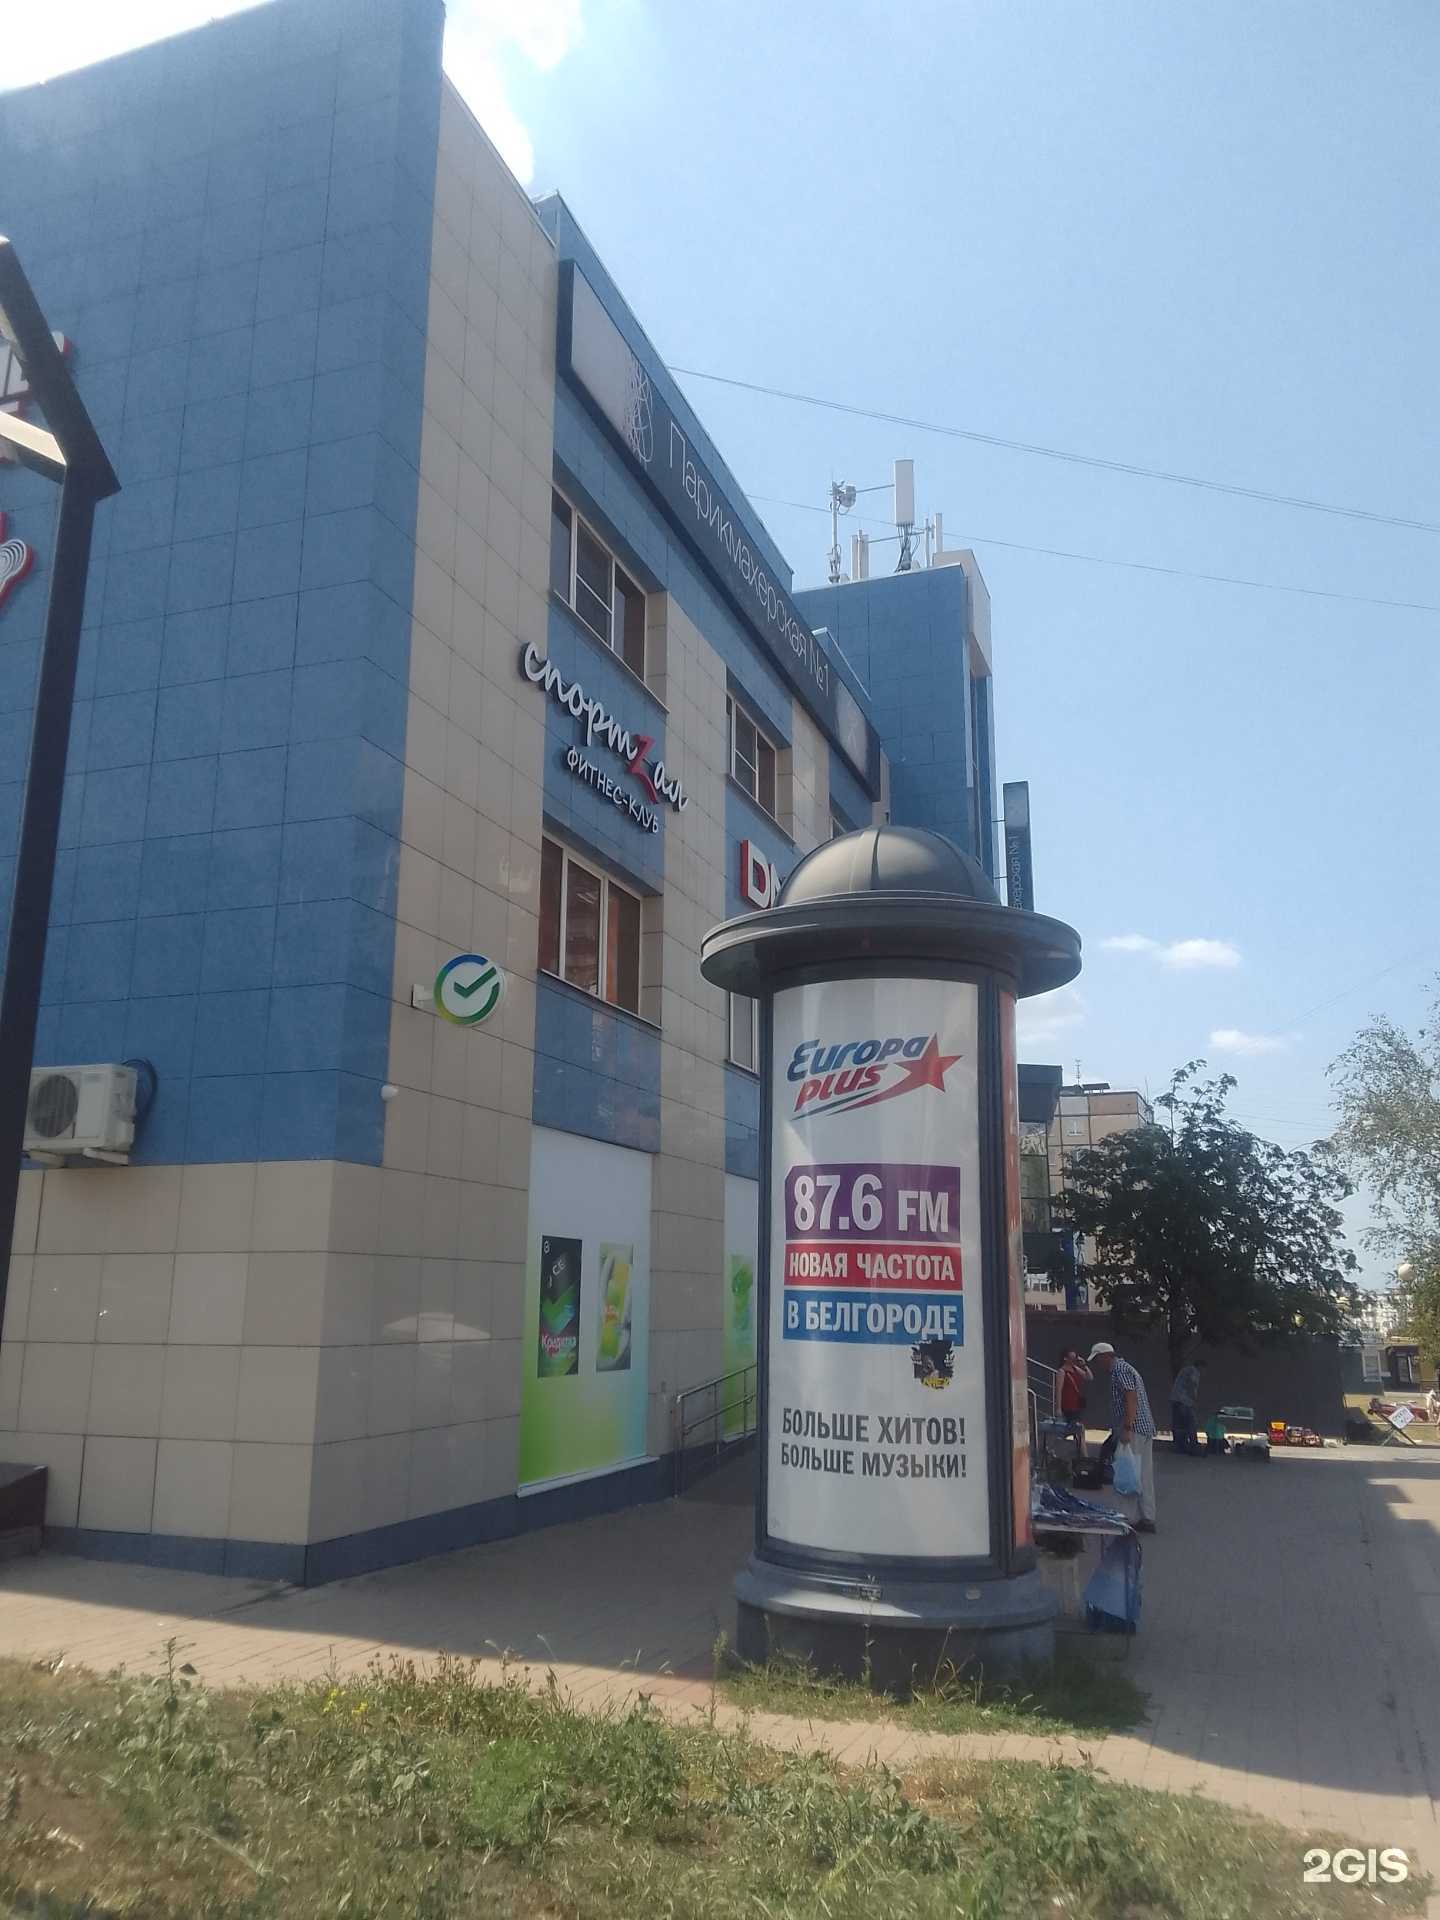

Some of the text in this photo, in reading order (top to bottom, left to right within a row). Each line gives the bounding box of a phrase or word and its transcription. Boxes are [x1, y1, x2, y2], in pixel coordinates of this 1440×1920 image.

[669, 420, 829, 696] Парикмахерская №1
[567, 746, 660, 834] ФИТНЕС-КЛУБ
[794, 1174, 949, 1233] 87.6 FM
[789, 1252, 956, 1281] НОВАЯ ЧАСТОТА
[787, 1300, 958, 1340] В БЕЛГОРОДЕ
[782, 1408, 966, 1445] БОЛЬШЕ ХИТОВ!
[781, 1442, 967, 1479] БОЛЬШЕ МУЗЫКИ!
